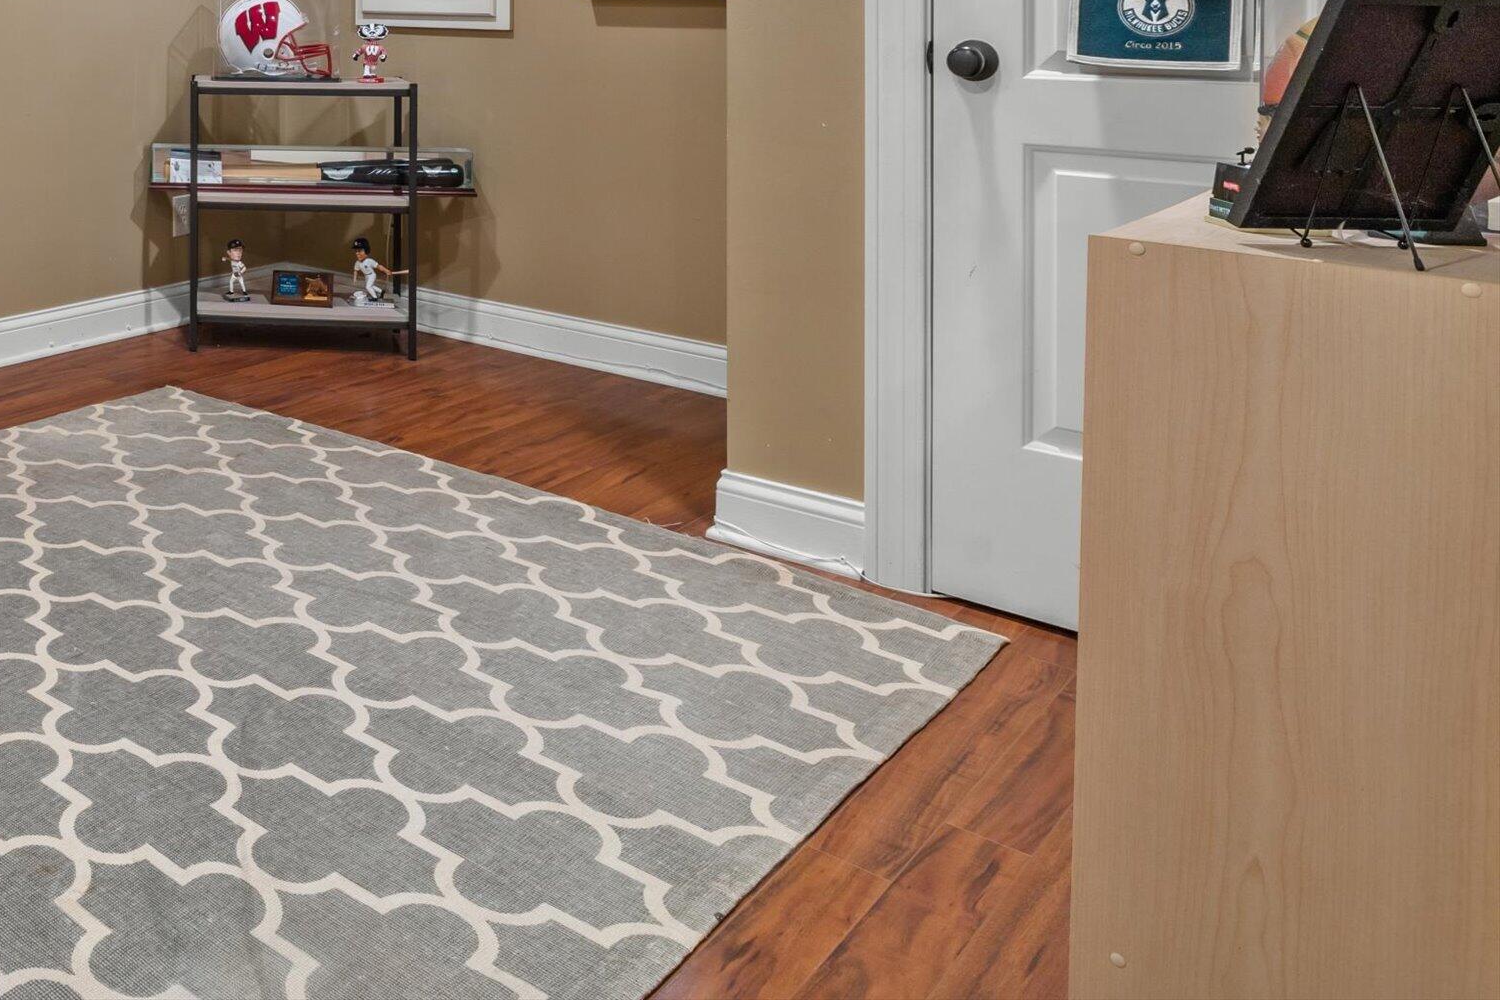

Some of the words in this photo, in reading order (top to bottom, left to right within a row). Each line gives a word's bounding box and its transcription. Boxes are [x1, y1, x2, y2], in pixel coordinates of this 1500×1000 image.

[234, 1, 282, 54] W
[1124, 10, 1165, 33] MILWAUKEE
[1164, 10, 1188, 31] BUCKS
[1125, 40, 1152, 49] Circa
[1155, 41, 1182, 50] 2015
